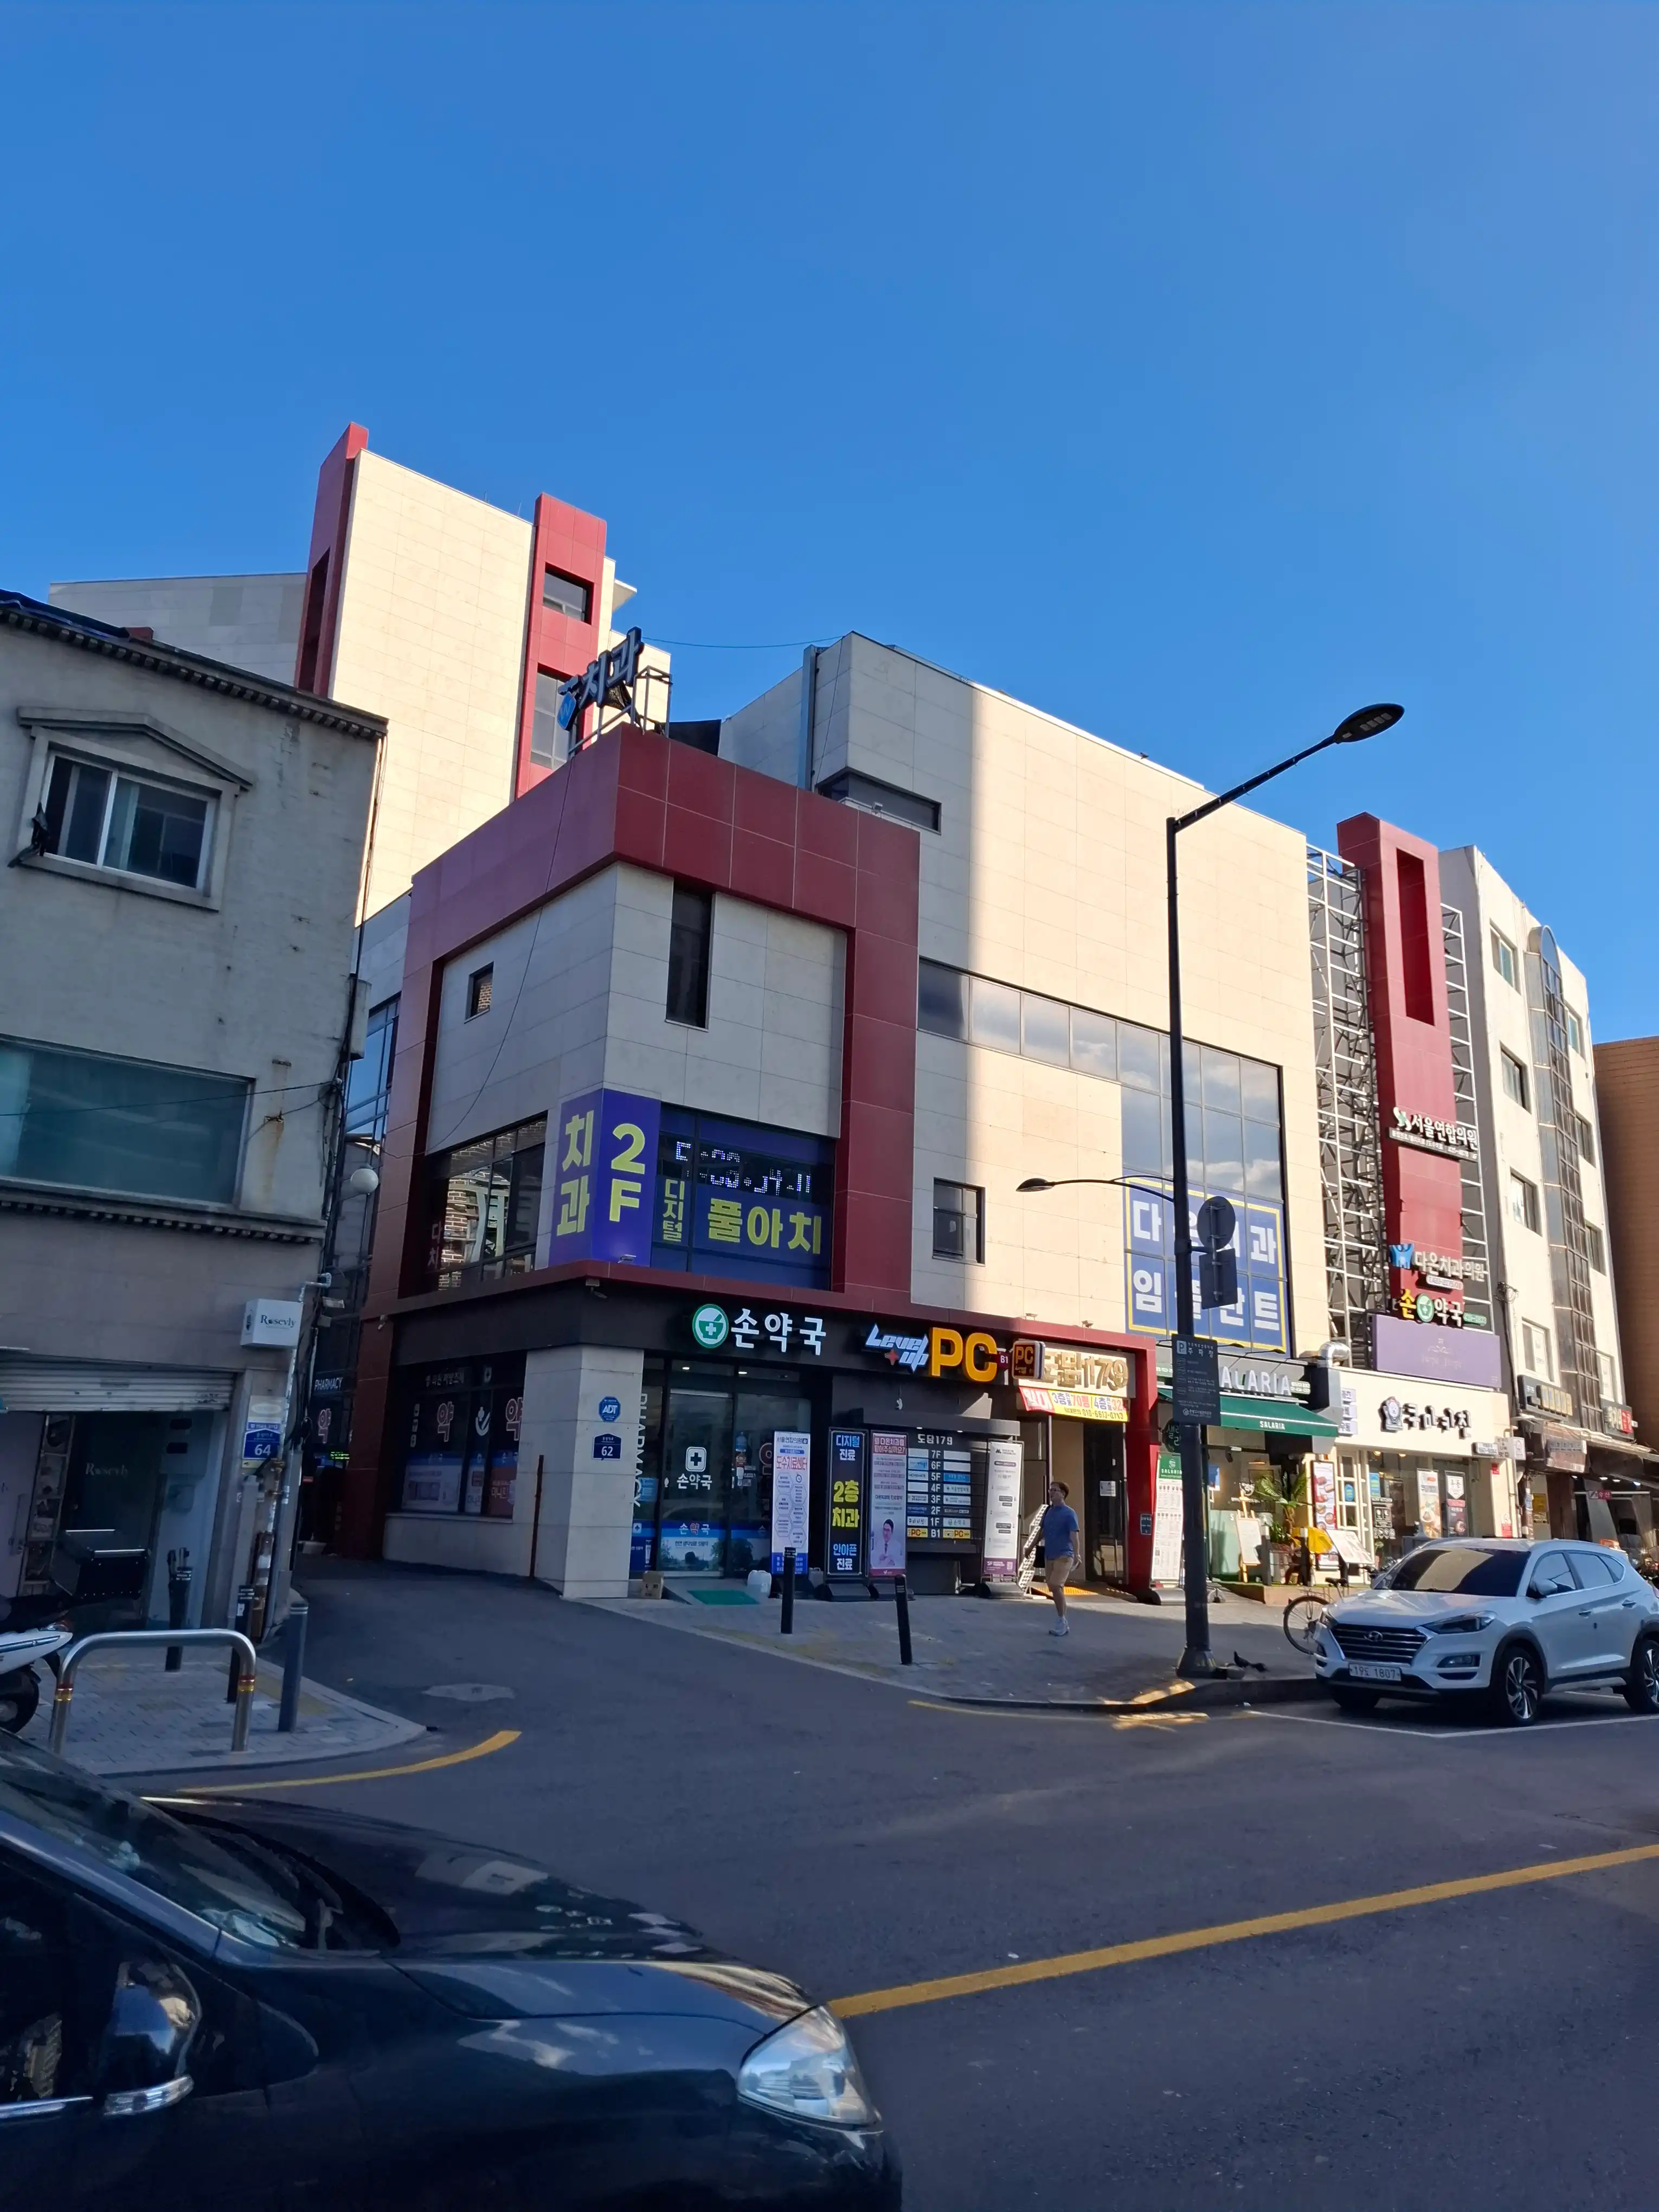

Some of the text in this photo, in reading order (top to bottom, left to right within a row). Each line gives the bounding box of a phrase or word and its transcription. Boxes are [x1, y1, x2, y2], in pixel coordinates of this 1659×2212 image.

[1411, 1114, 1478, 1150] 서울연합의원
[557, 1110, 594, 1237] 치과
[609, 1123, 645, 1222] 2F
[663, 1179, 685, 1243] 디지털
[708, 1198, 821, 1255] 풀아치
[1133, 1200, 1277, 1264] 다과
[1413, 1251, 1485, 1282] 다온치과의원
[1399, 1289, 1417, 1319] 손
[1434, 1297, 1463, 1327] 약국
[731, 1308, 827, 1356] 손약국
[866, 1323, 929, 1352] Level
[931, 1327, 997, 1382] PC
[1000, 1355, 1008, 1364] B1
[1016, 1346, 1033, 1365] PC
[899, 1351, 929, 1373] up
[314, 1377, 343, 1390] PHARMACY
[1220, 1366, 1292, 1396] ALARIA
[602, 1405, 618, 1414] ADT
[1259, 1420, 1285, 1430] SALARIA
[836, 1435, 860, 1448] 디지털
[917, 1434, 953, 1445] 도담179
[254, 1444, 272, 1456] 64
[601, 1446, 614, 1457] 62
[839, 1449, 856, 1461] 진료
[931, 1450, 941, 1459] 7F
[931, 1461, 941, 1470] 6F
[677, 1472, 713, 1490] 손약국
[931, 1472, 941, 1481] 5F
[833, 1480, 859, 1502] 2층
[931, 1483, 941, 1492] 4F
[931, 1495, 941, 1504] 3F
[931, 1506, 941, 1515] 2F
[832, 1507, 860, 1528] 치과
[930, 1517, 940, 1527] 1F
[679, 1522, 711, 1536] 손약국
[931, 1529, 941, 1538] B1
[833, 1544, 857, 1557] 안아픈
[837, 1558, 853, 1571] 진료
